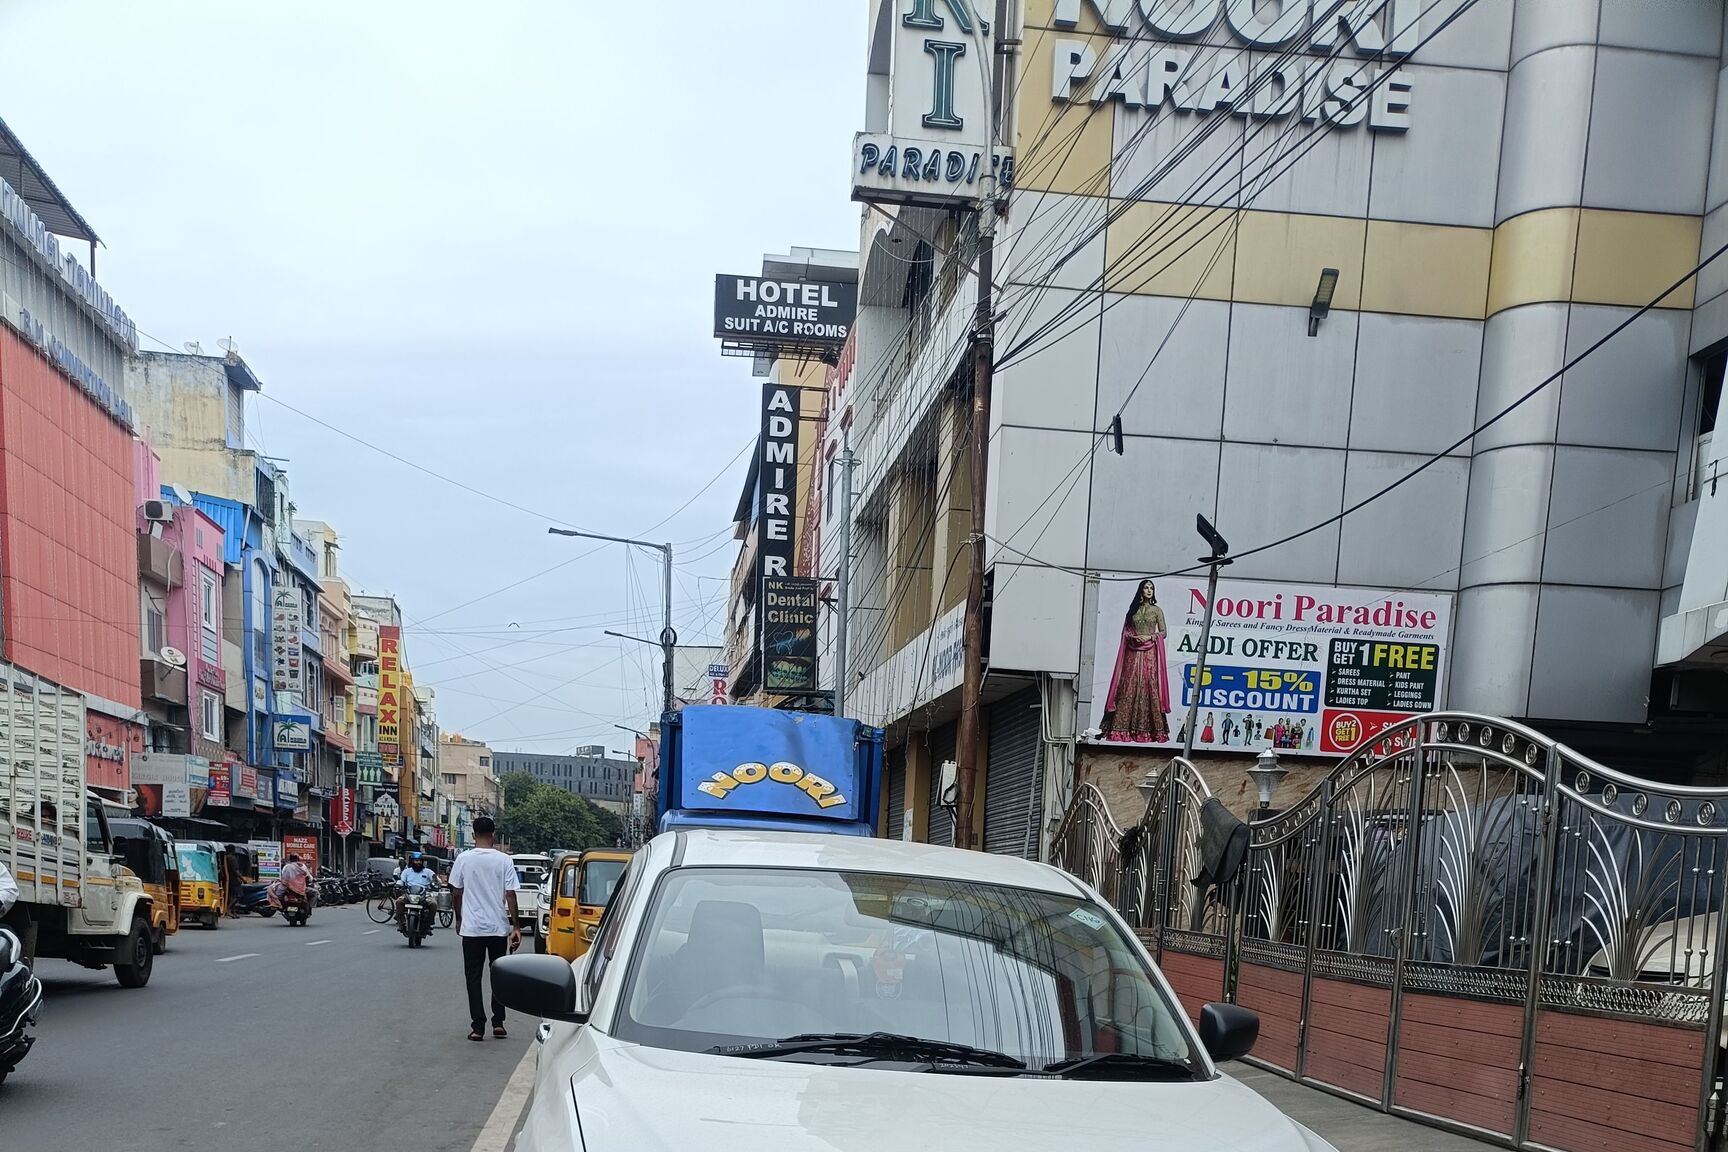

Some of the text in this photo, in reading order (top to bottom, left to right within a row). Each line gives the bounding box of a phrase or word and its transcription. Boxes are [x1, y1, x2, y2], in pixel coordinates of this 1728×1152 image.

[1051, 39, 1414, 133] PARADISE
[736, 279, 838, 308] HOTEL
[754, 305, 818, 321] ADMIRE
[724, 317, 848, 338] SUIT A/C ROOMS
[764, 390, 793, 541] ADMIRE
[768, 581, 784, 590] NK
[767, 592, 815, 607] Dental
[1186, 588, 1436, 630] Noori Paradise
[767, 610, 814, 624] Clinic
[1216, 619, 1241, 629] Sarees
[1243, 621, 1258, 629] and
[1260, 622, 1285, 632] Fancy
[1285, 623, 1307, 633] Dress
[1308, 625, 1342, 635] Material
[1343, 627, 1351, 635] &
[1352, 628, 1397, 638] Readymade
[1398, 631, 1435, 640] Garments
[1241, 638, 1319, 662] OFFER
[1334, 641, 1358, 653] BUY
[1333, 643, 1436, 670] GET 1 FREE
[1189, 666, 1212, 686] 5
[1242, 670, 1313, 692] 15%
[1337, 668, 1361, 676] SAREES
[1395, 672, 1411, 680] PANT
[380, 638, 398, 724] RELAX
[1337, 678, 1386, 688] DRESS MATERIAL
[1394, 681, 1425, 690] KIDS PANT
[1336, 687, 1359, 695] KURTHA
[1393, 690, 1422, 699] LEGGINGS
[1186, 688, 1315, 711] DISCOUNT
[1335, 696, 1369, 706] LADIES TOP
[1392, 700, 1432, 709] LADIES GOWN
[379, 725, 398, 736] INN
[1335, 721, 1351, 729] BUY
[1350, 727, 1356, 741] 1
[696, 761, 848, 809] NOORI
